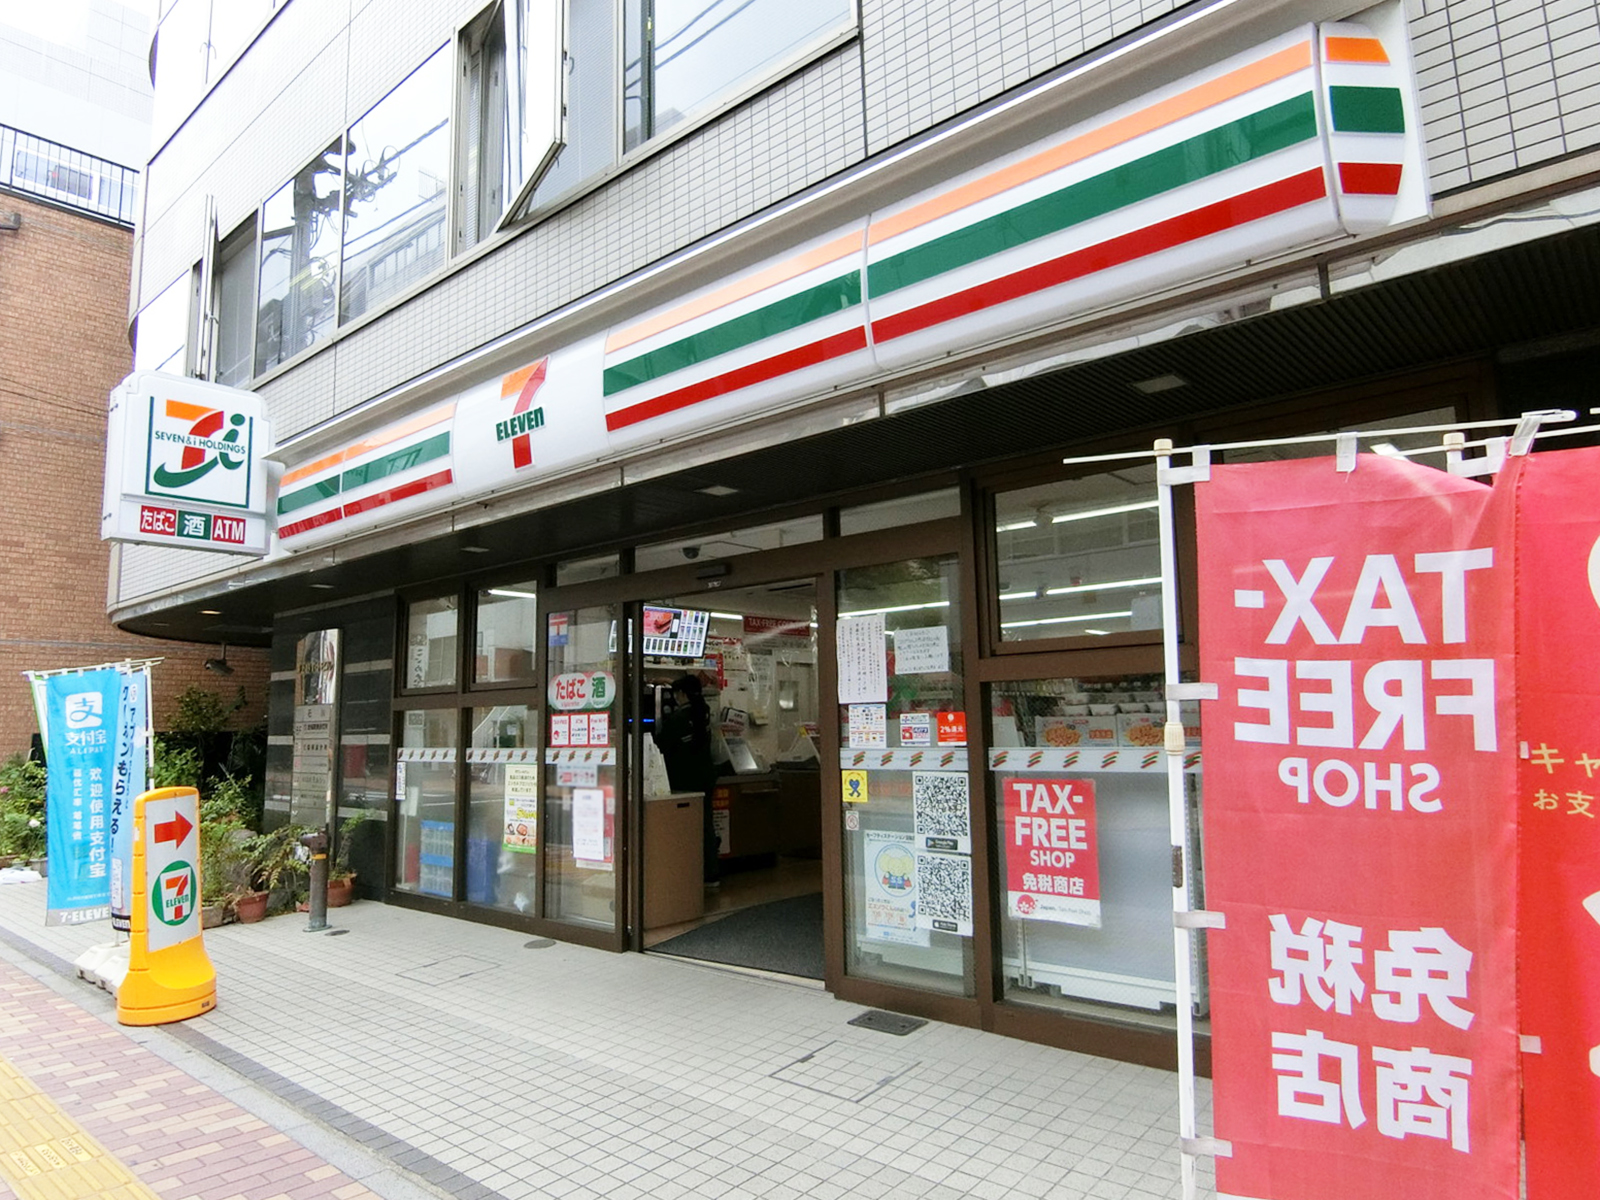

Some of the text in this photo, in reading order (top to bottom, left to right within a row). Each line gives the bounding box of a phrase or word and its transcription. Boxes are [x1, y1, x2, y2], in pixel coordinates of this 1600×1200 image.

[199, 440, 246, 455] HOLDINGS
[141, 509, 176, 534] たばこ
[183, 514, 205, 537] 酒
[214, 518, 244, 542] ATM
[556, 677, 586, 700] たばこ
[592, 676, 606, 699] 酒
[65, 729, 107, 747] 支付宝
[1012, 782, 1084, 816] TAX-
[88, 767, 106, 878] 欢迎使用支付宝
[1014, 816, 1088, 850] FREE
[1030, 849, 1076, 869] SHOP
[1022, 872, 1085, 896] 免税商店
[60, 906, 110, 923] 7-ELEVE
